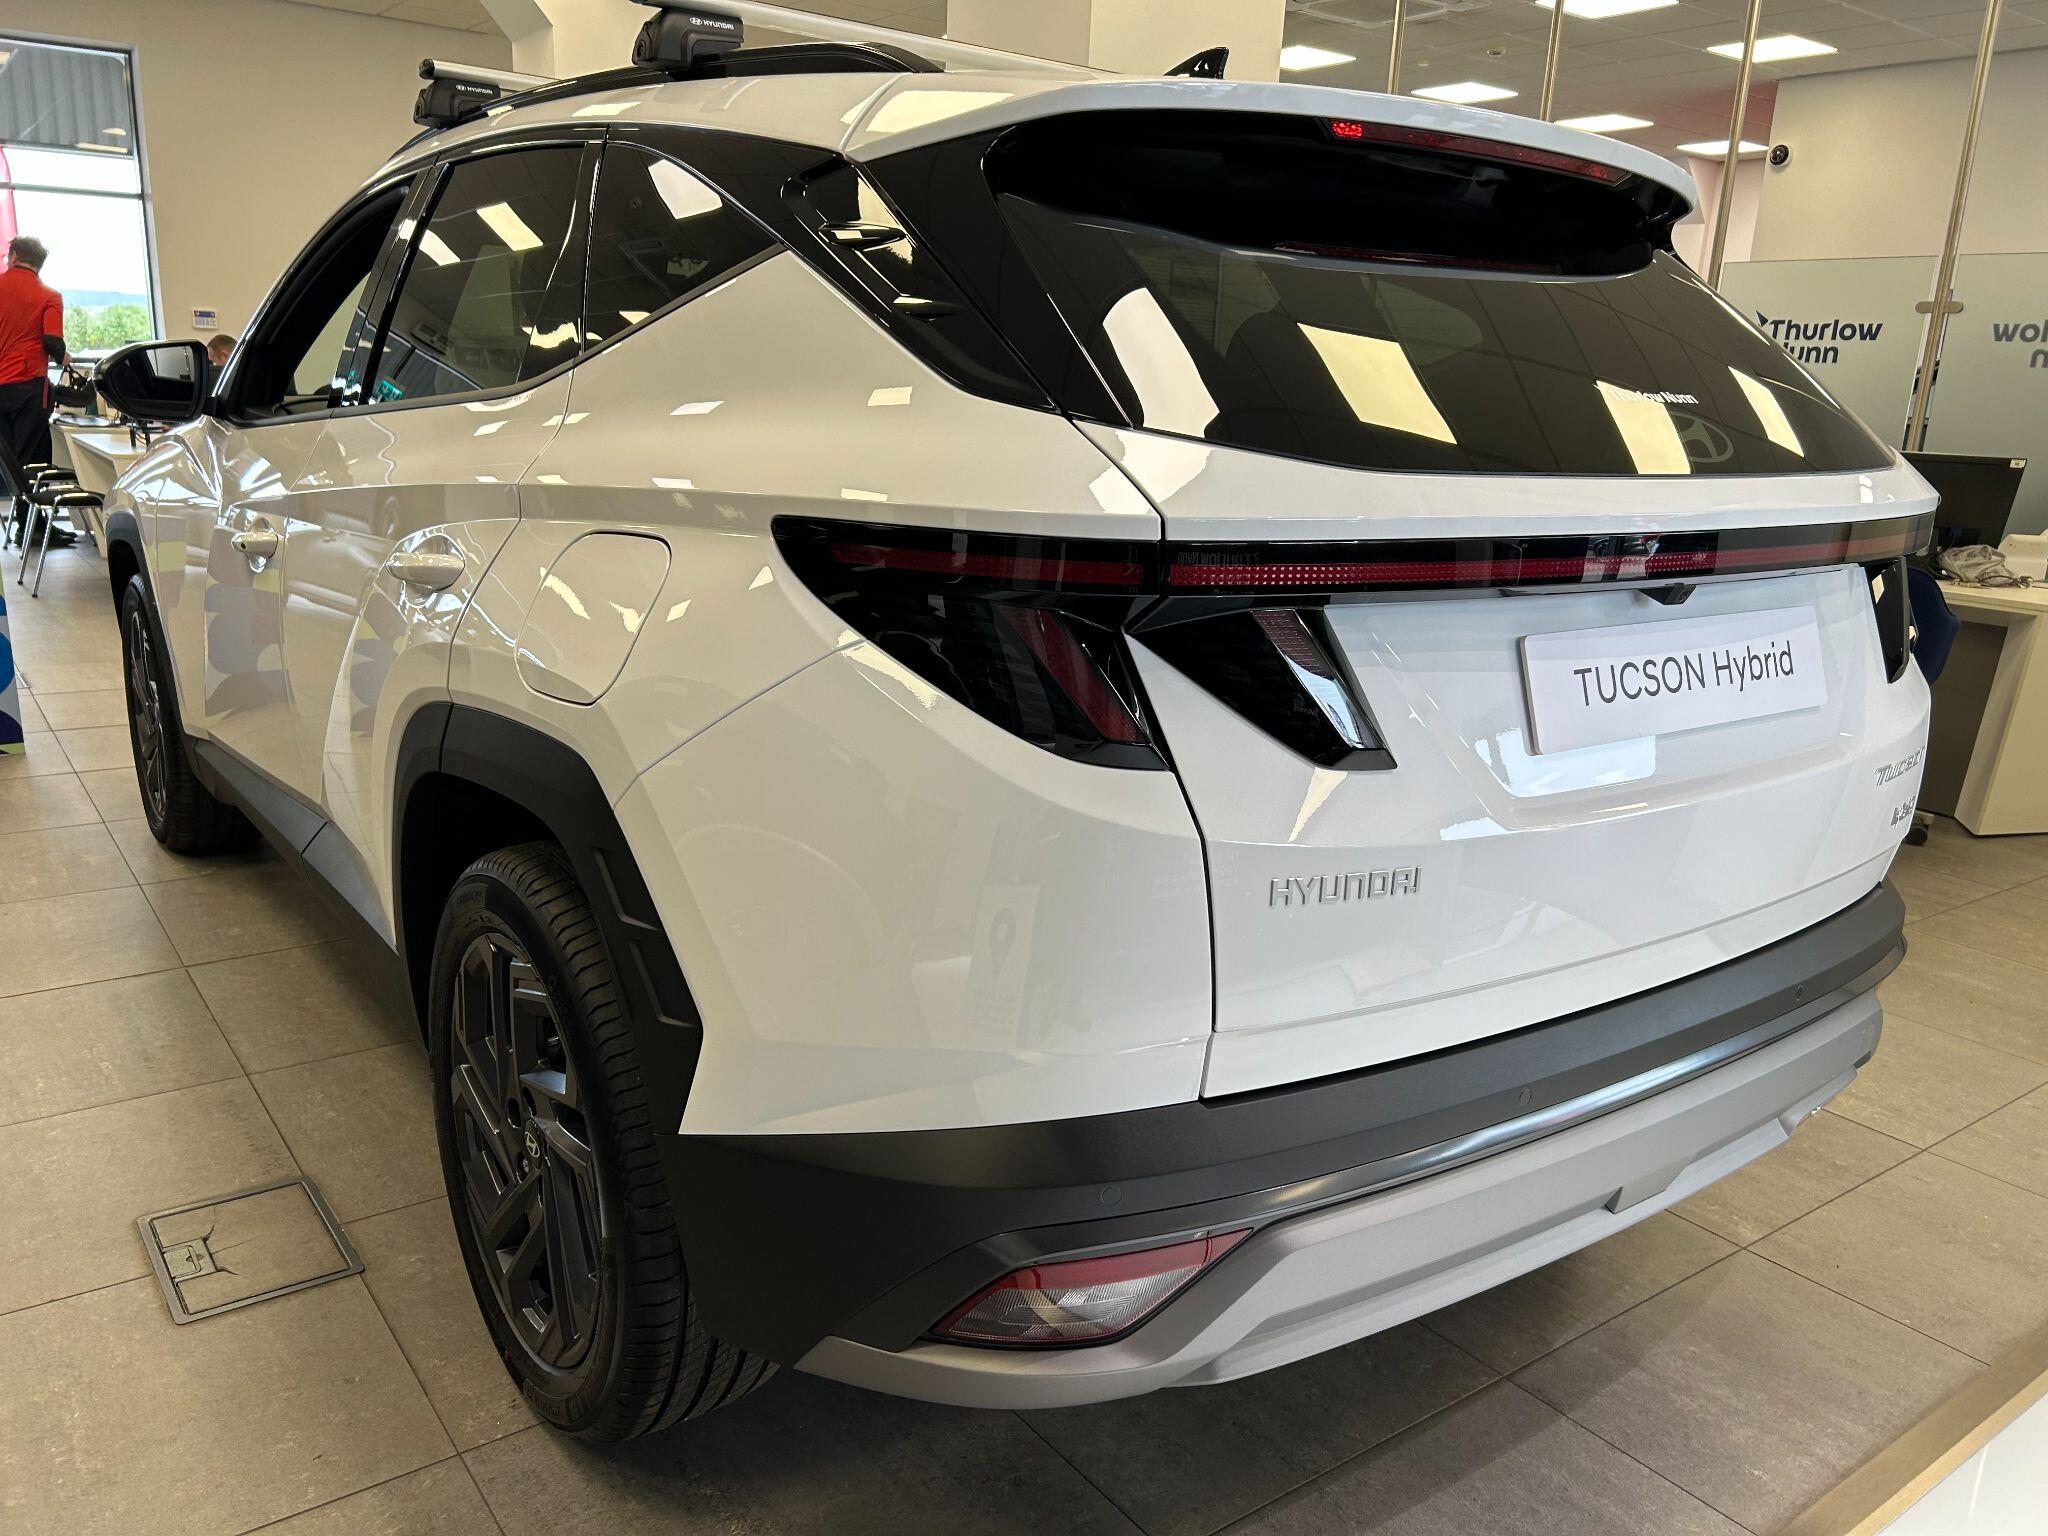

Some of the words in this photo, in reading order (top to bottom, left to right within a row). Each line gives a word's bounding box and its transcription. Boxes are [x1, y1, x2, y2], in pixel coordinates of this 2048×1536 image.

[703, 19, 735, 30] HYUNDAI
[1769, 319, 1883, 341] Thurlow
[1783, 342, 1838, 363] unn
[1660, 391, 1699, 404] Nunn
[1573, 653, 1706, 707] TUCSON
[1712, 640, 1795, 692] Hybrid
[1269, 866, 1423, 907] HYUNDAI
